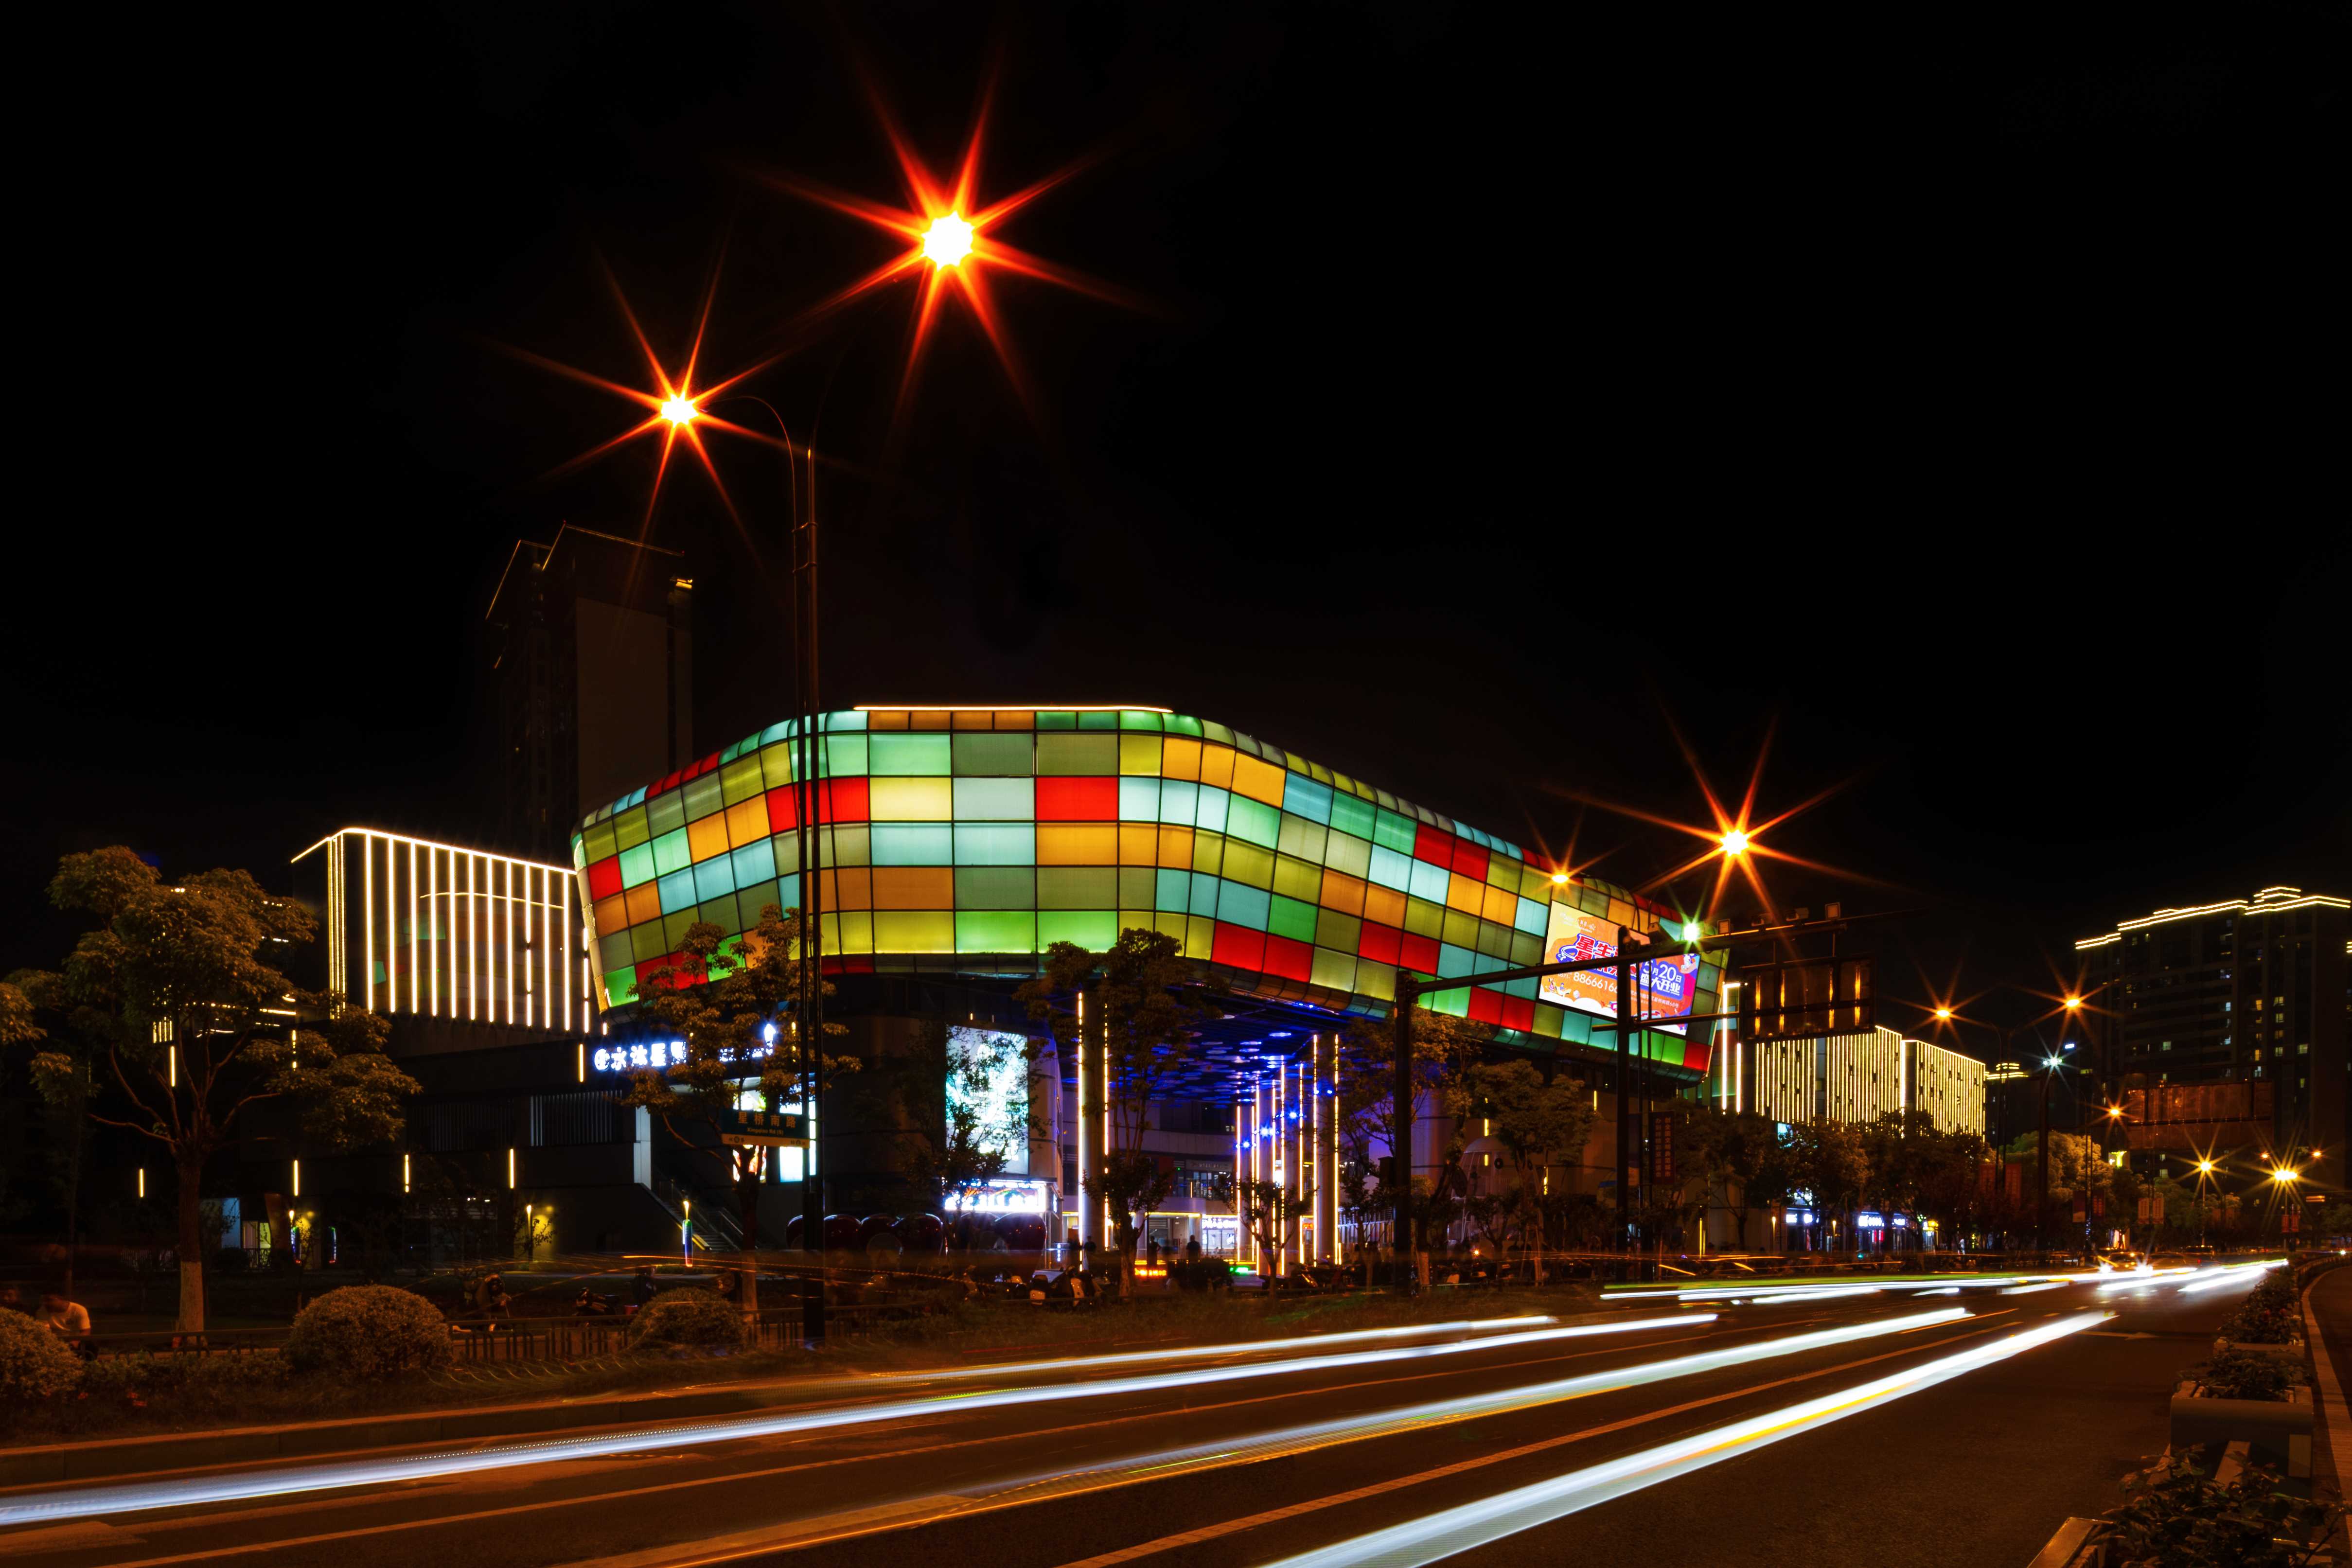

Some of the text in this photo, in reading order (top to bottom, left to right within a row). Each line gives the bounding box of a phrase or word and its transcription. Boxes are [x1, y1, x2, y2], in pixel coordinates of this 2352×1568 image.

[1643, 961, 1682, 983] 5月20日
[1640, 973, 1681, 994] 盛大开业
[738, 1111, 796, 1128] 星桥南路
